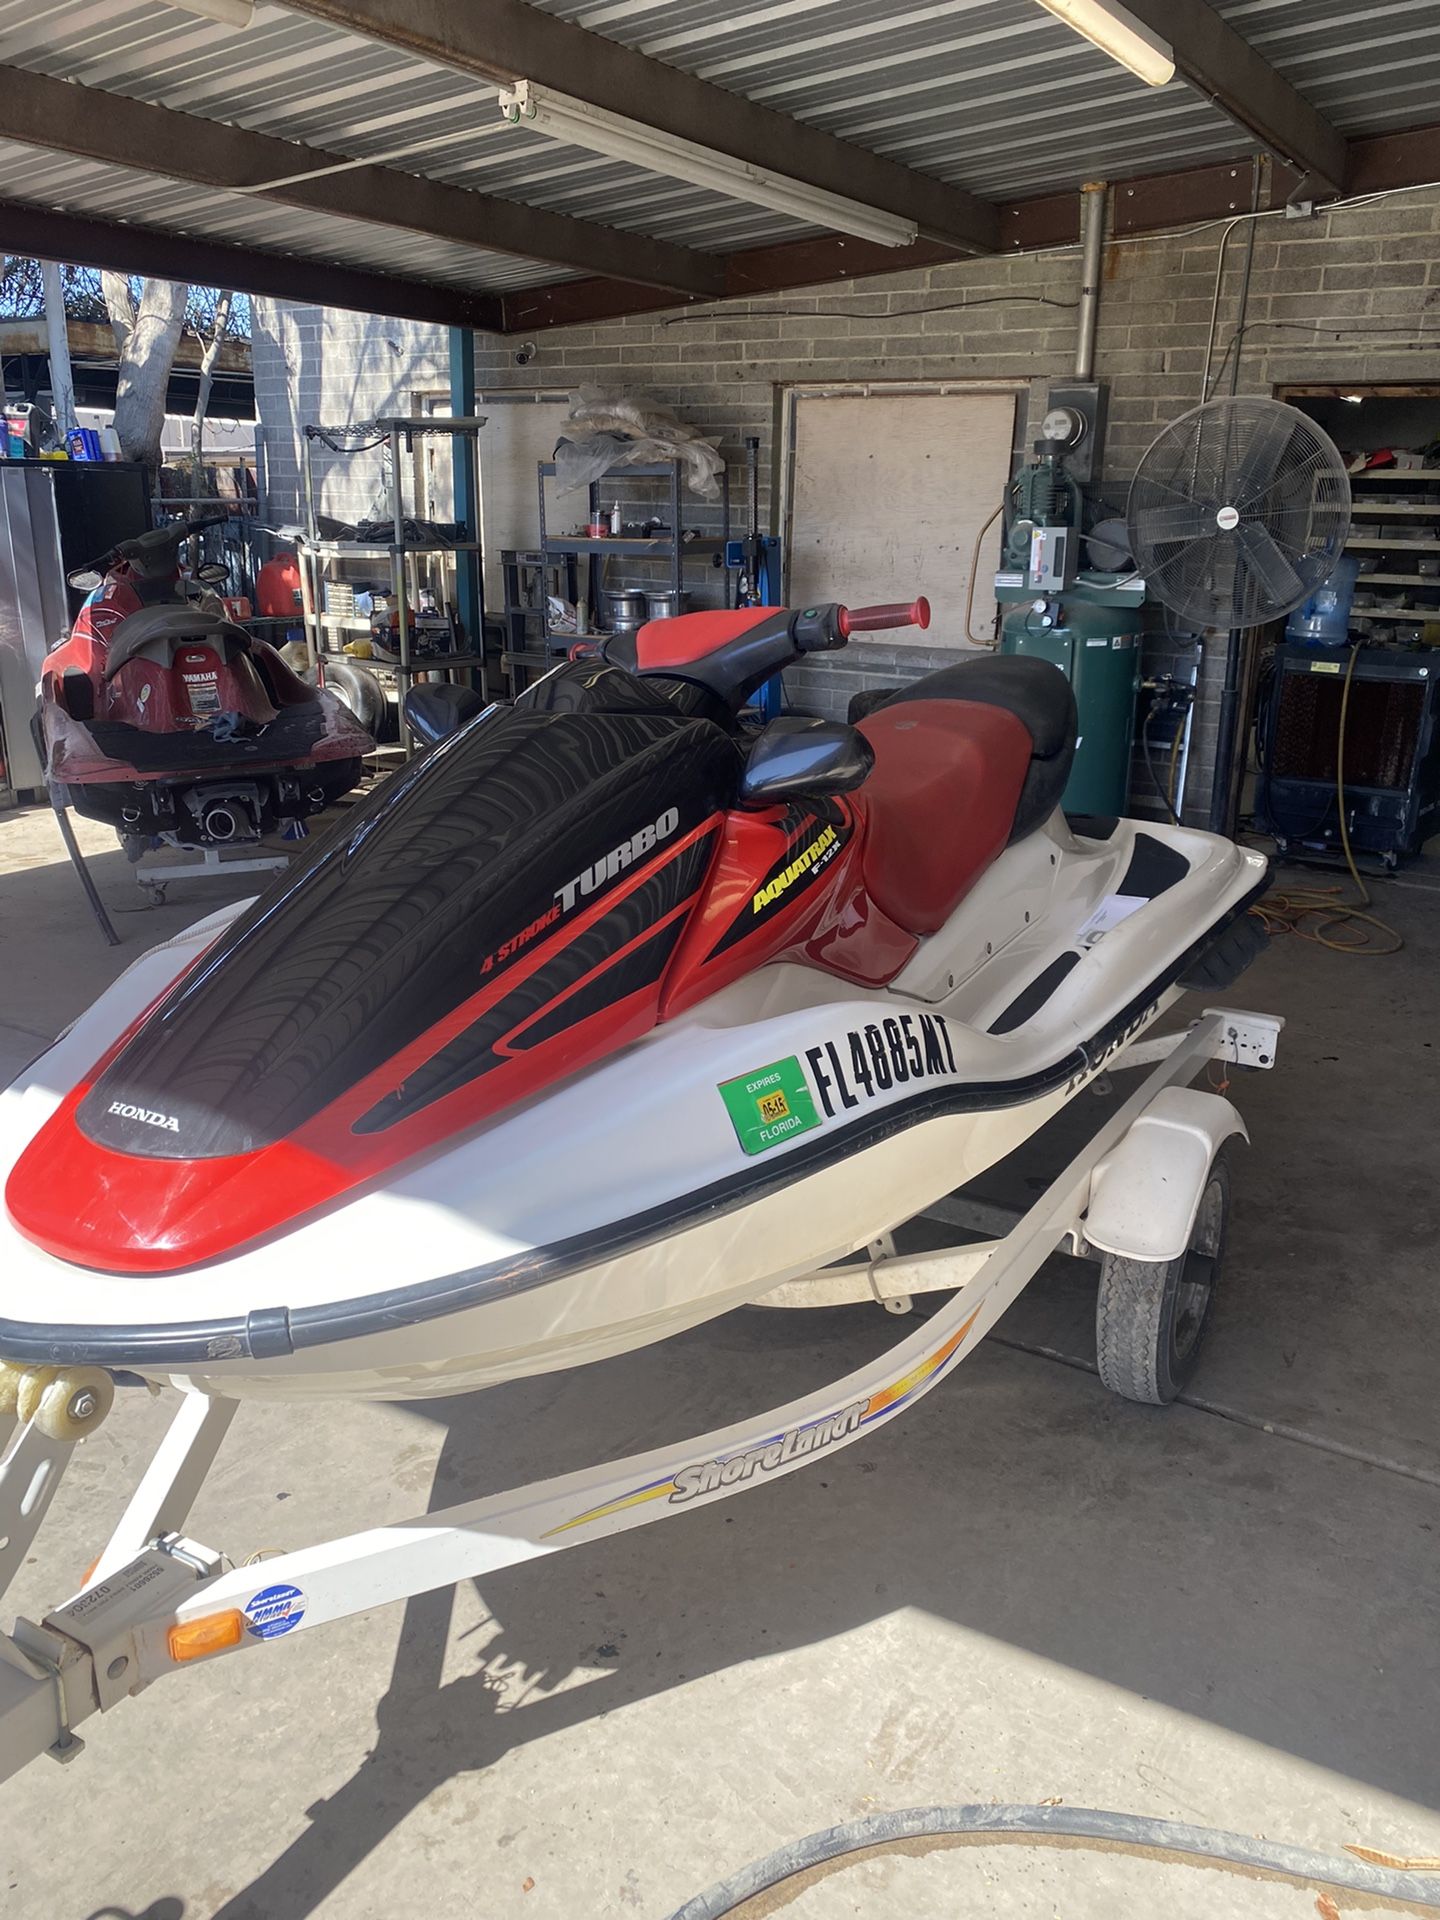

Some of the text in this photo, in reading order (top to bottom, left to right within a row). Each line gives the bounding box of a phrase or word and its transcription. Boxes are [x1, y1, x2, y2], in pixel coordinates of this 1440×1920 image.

[182, 671, 218, 682] YAMAHA
[753, 824, 837, 914] AQUATRAX
[811, 840, 841, 875] F-12X
[480, 806, 679, 975] 4 STROKE TURBO
[746, 1072, 782, 1094] EXPIRES
[107, 1101, 180, 1132] HONDA
[759, 1115, 802, 1142] FLORIDA
